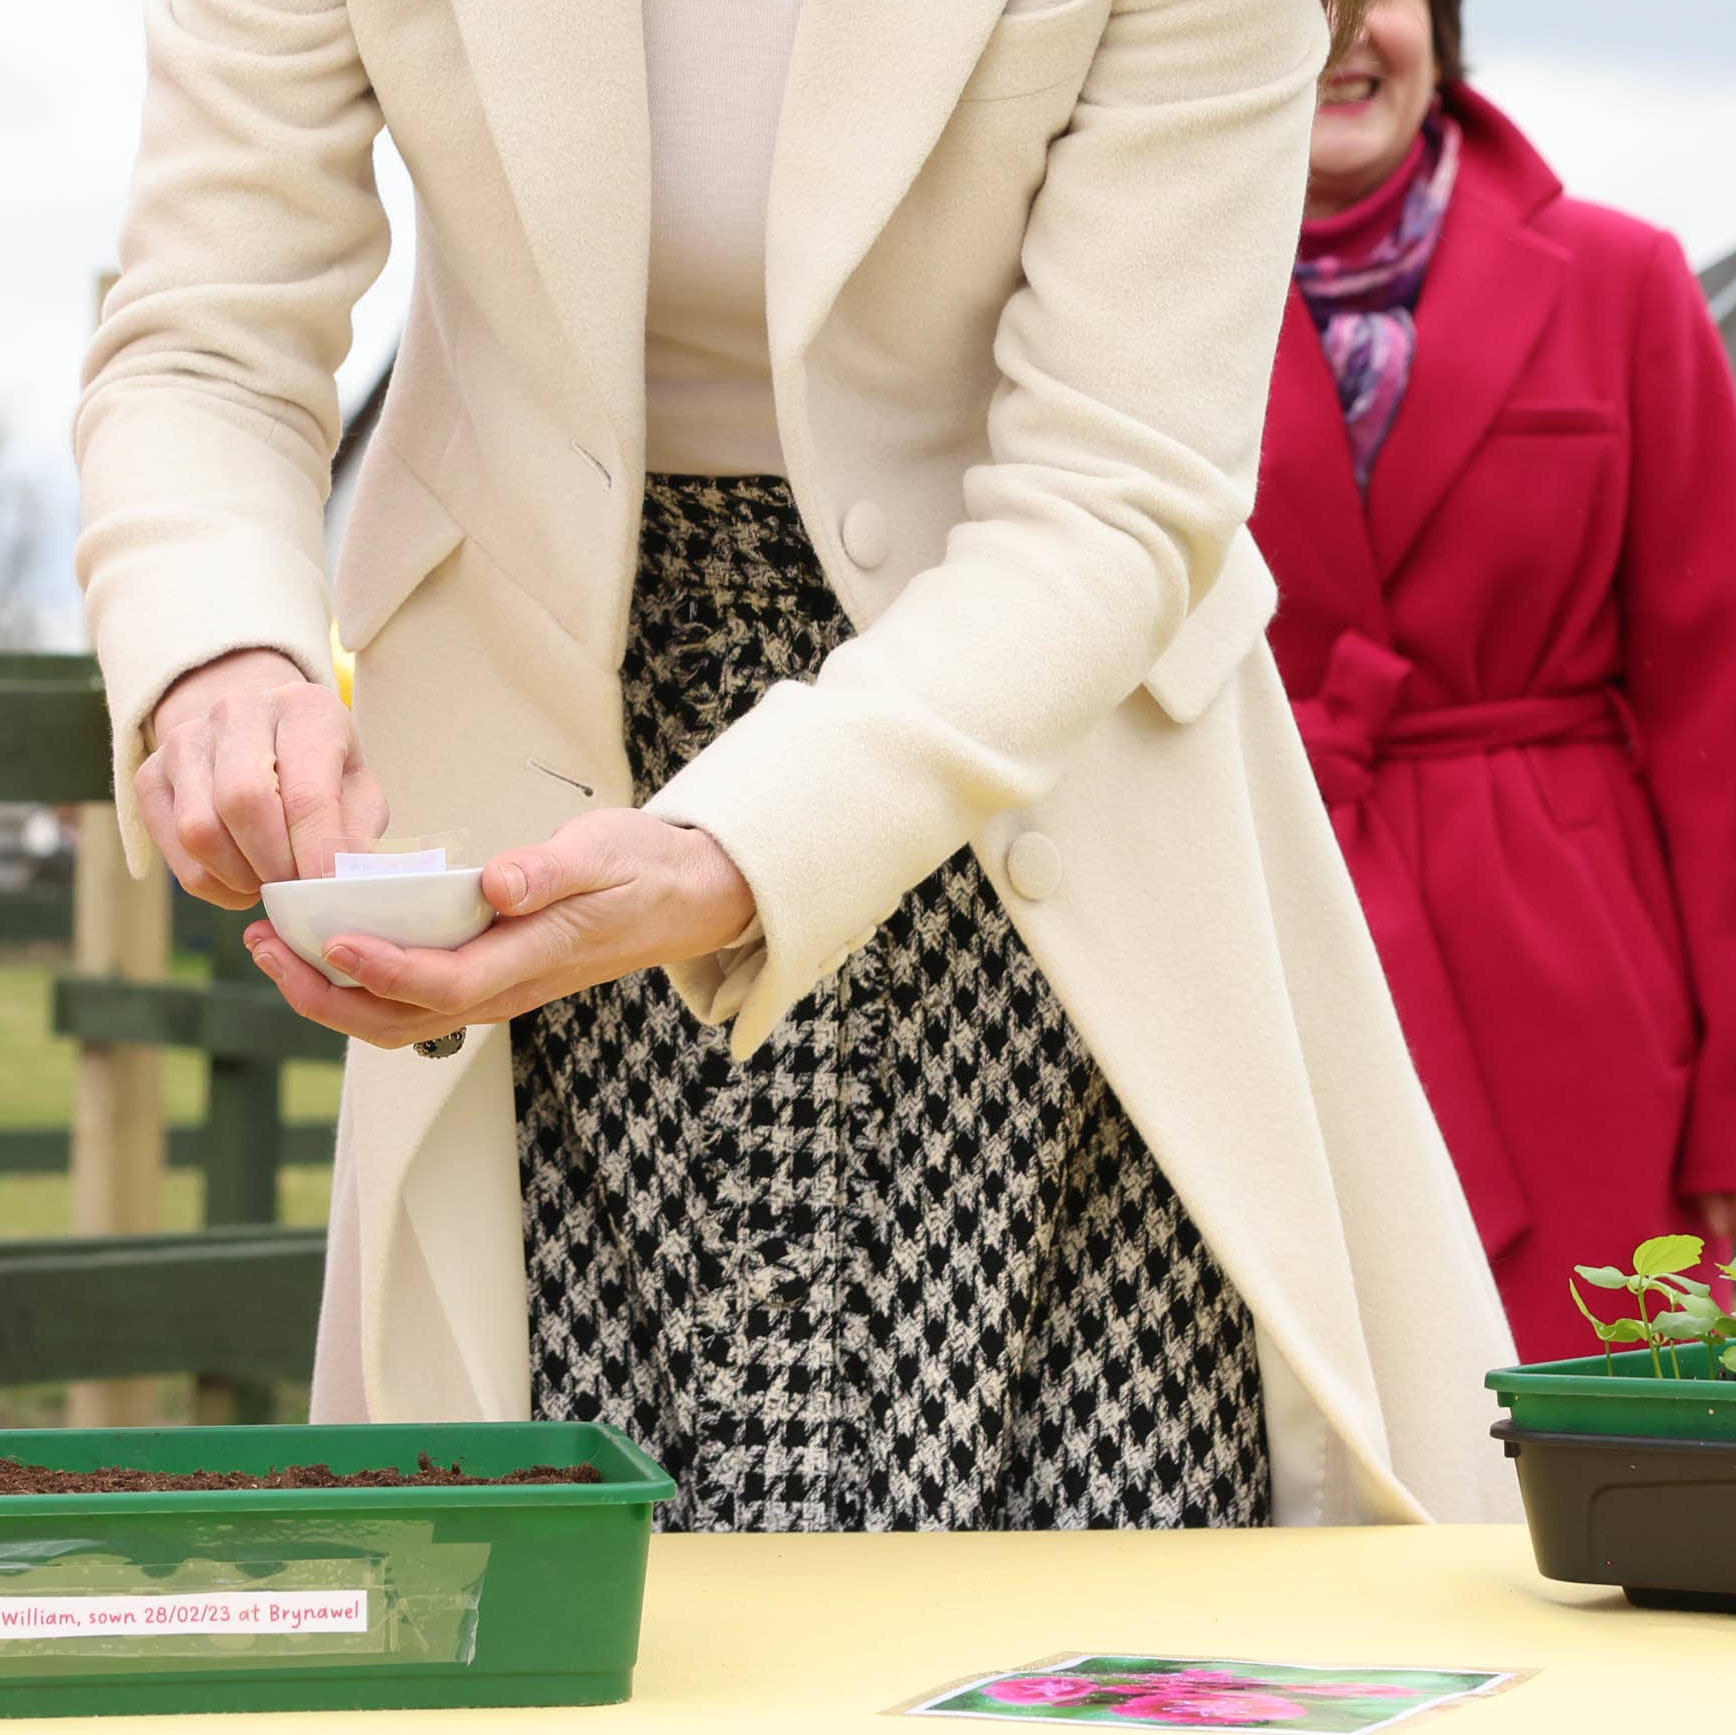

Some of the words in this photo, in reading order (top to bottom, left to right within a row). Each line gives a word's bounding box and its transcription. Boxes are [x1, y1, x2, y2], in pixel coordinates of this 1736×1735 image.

[1, 1607, 82, 1628] William,
[89, 1611, 136, 1625] sown
[145, 1605, 231, 1625] 28/02/23
[239, 1604, 260, 1623] at
[269, 1600, 359, 1629] Brynawel
